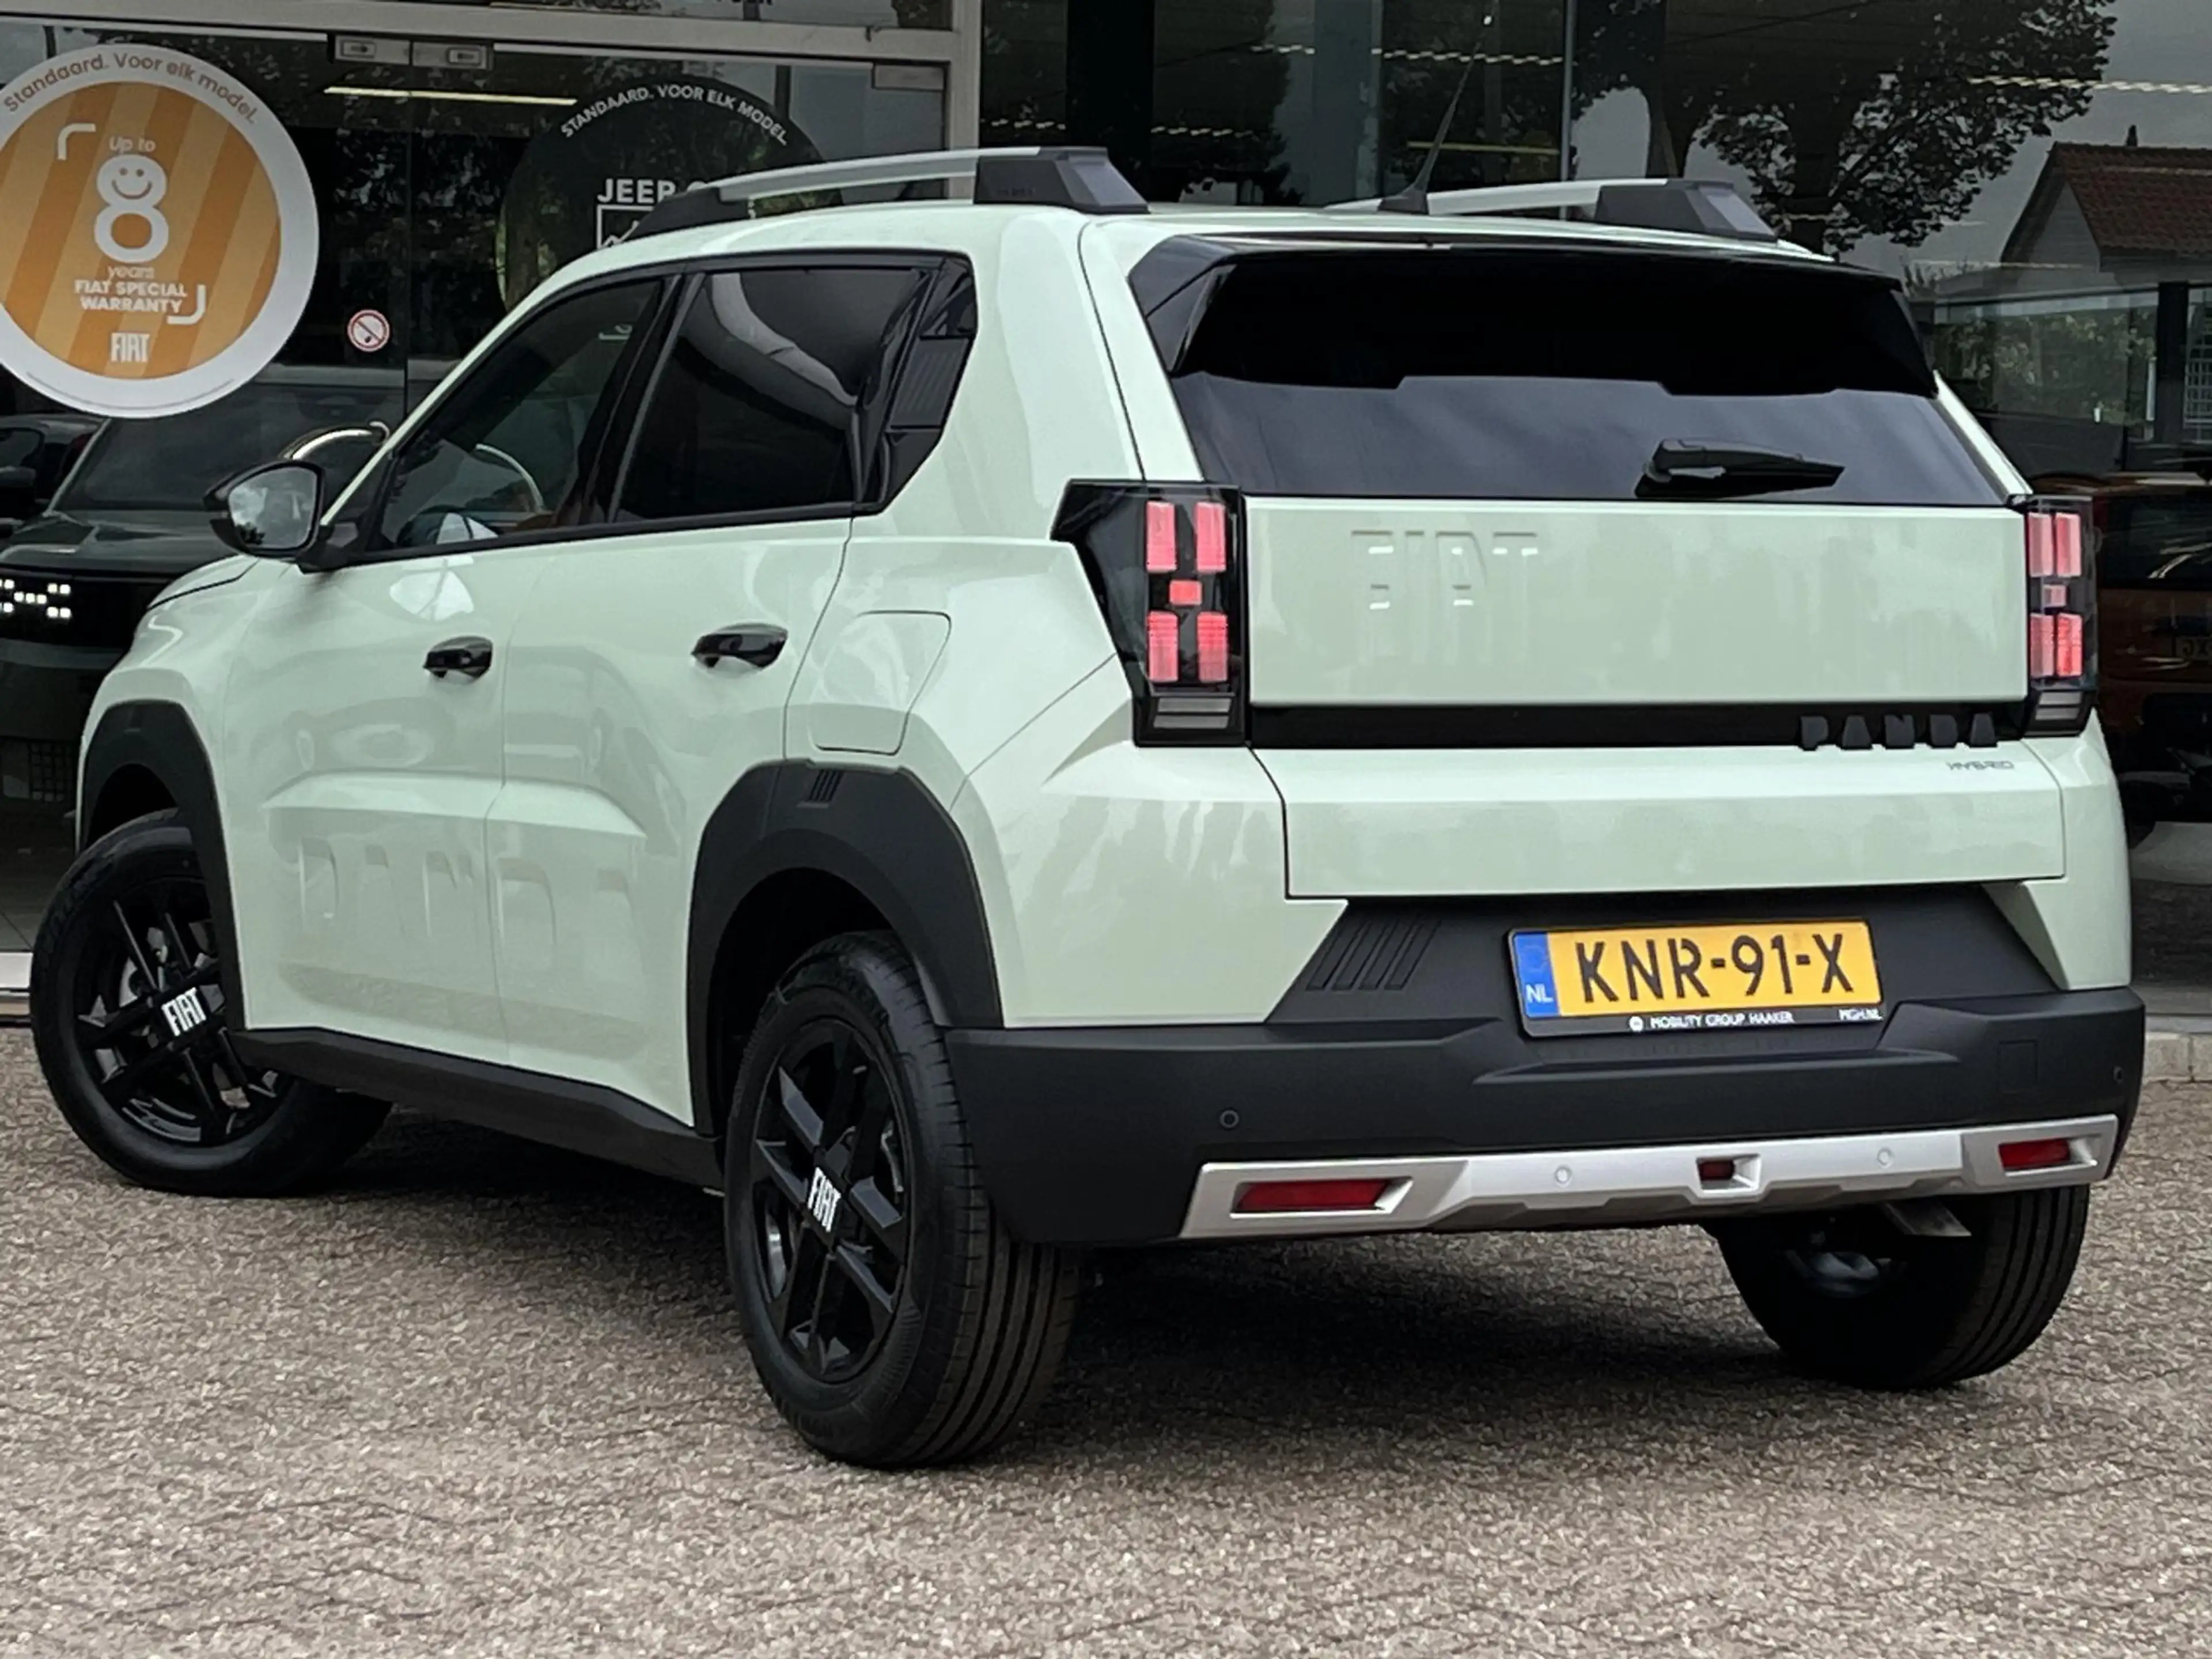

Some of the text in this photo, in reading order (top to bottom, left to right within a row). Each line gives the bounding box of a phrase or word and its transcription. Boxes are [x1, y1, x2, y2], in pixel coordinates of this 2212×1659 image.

[113, 52, 163, 70] Voor
[166, 62, 196, 81] elk
[657, 84, 704, 101] VOOR
[706, 89, 737, 111] ELK
[109, 136, 157, 154] Up to
[597, 178, 676, 204] JEEP
[94, 154, 169, 264] 8
[74, 279, 188, 297] FIAT SPECIAL
[107, 266, 155, 283] years
[79, 296, 182, 313] WARRANTY
[110, 332, 150, 363] FIAT
[1800, 713, 1997, 750] PANDA
[1575, 933, 1854, 1003] KNR-91-X
[1525, 983, 1554, 1003] NL
[161, 987, 207, 1036] FIAT
[1650, 1010, 1795, 1029] MOBILITY GROUP HAAKER
[808, 1166, 842, 1233] FIAT
